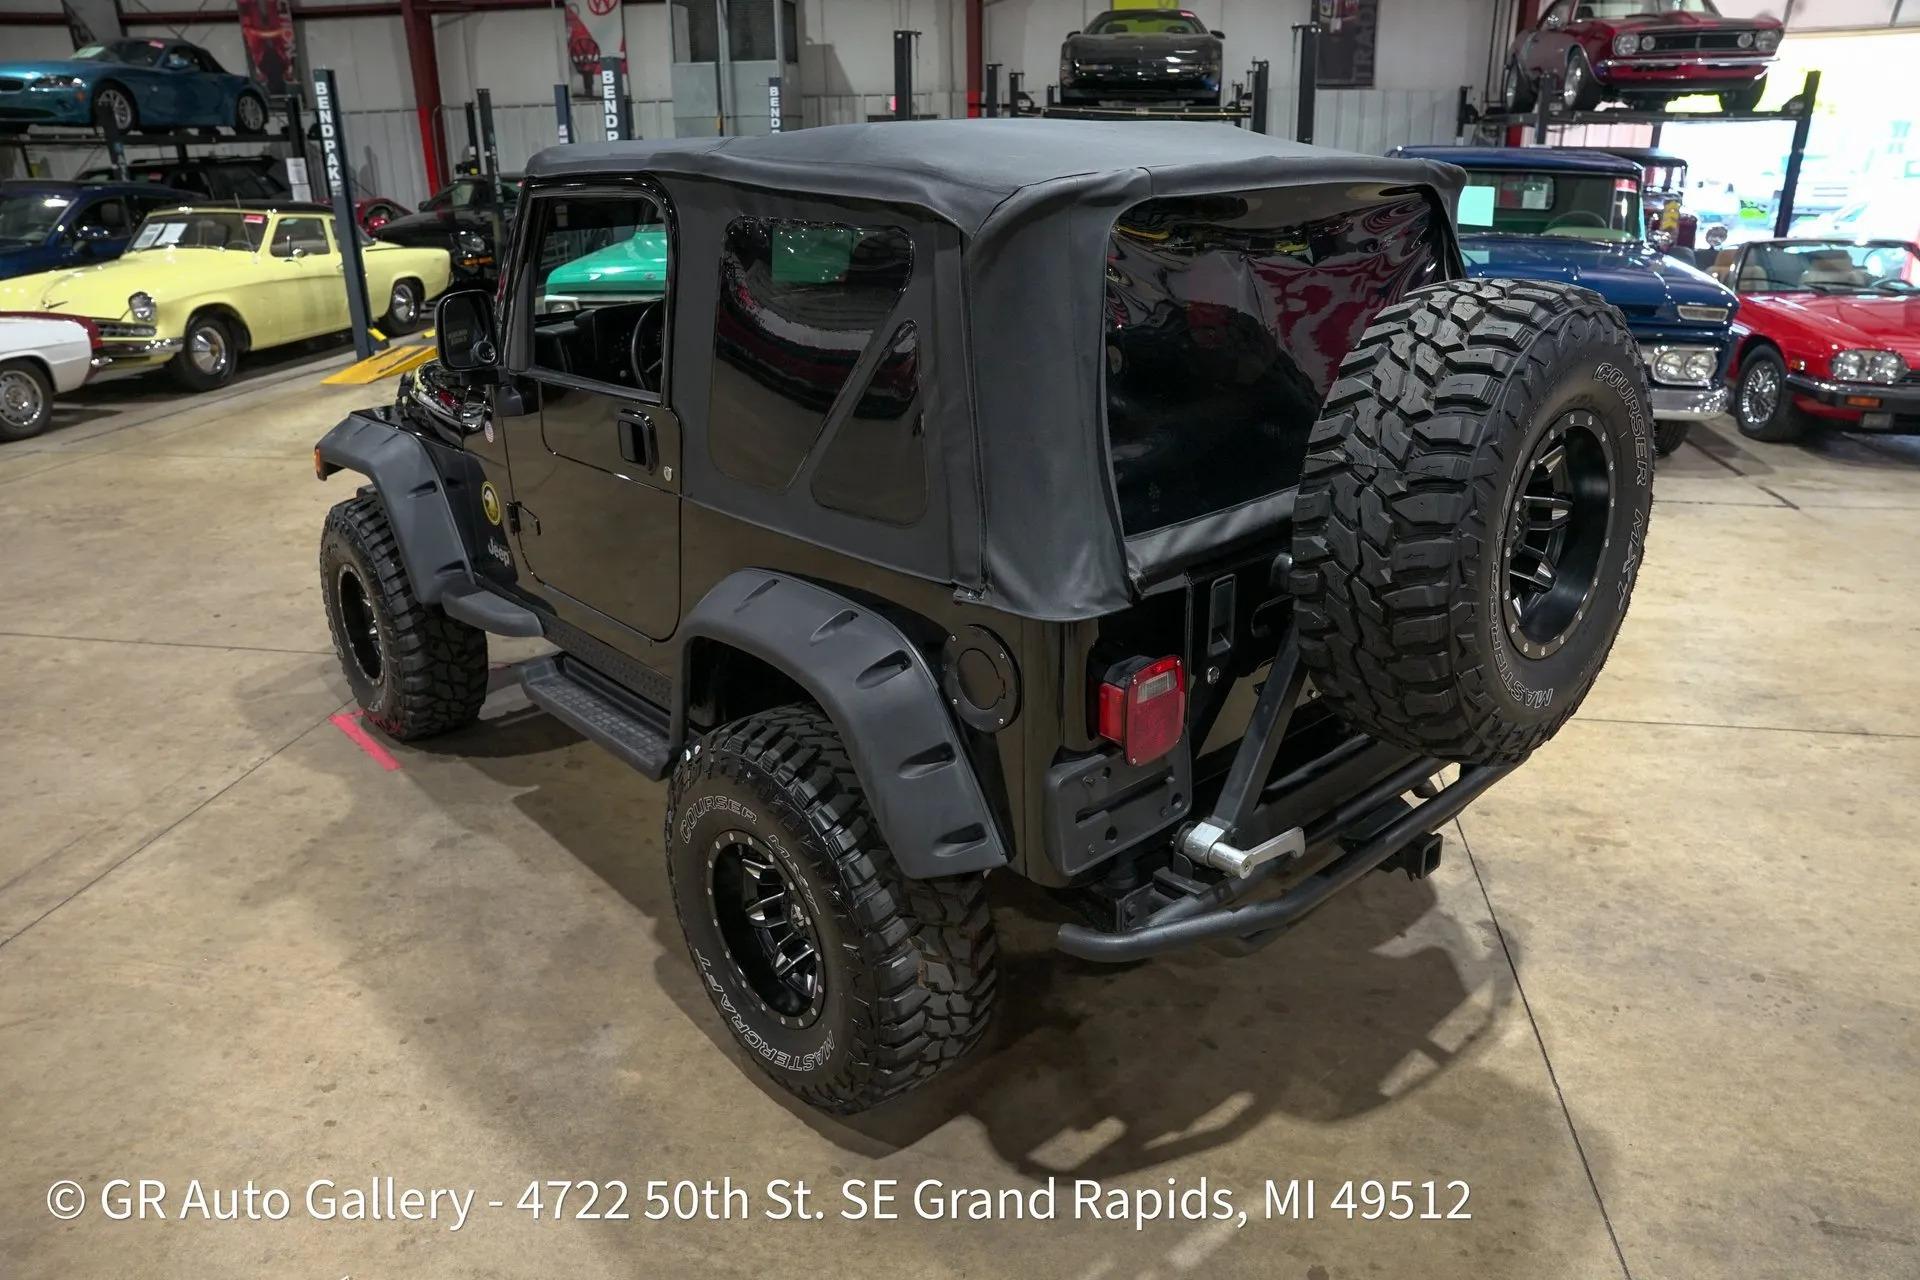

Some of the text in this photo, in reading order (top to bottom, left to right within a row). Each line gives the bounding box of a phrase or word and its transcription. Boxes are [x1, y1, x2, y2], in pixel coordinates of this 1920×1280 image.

[314, 81, 341, 180] BENDPAK
[1593, 361, 1648, 486] COURSER
[487, 537, 510, 568] Jeep
[679, 795, 759, 845] COURSER
[695, 948, 836, 1072] MASTERCRAFT
